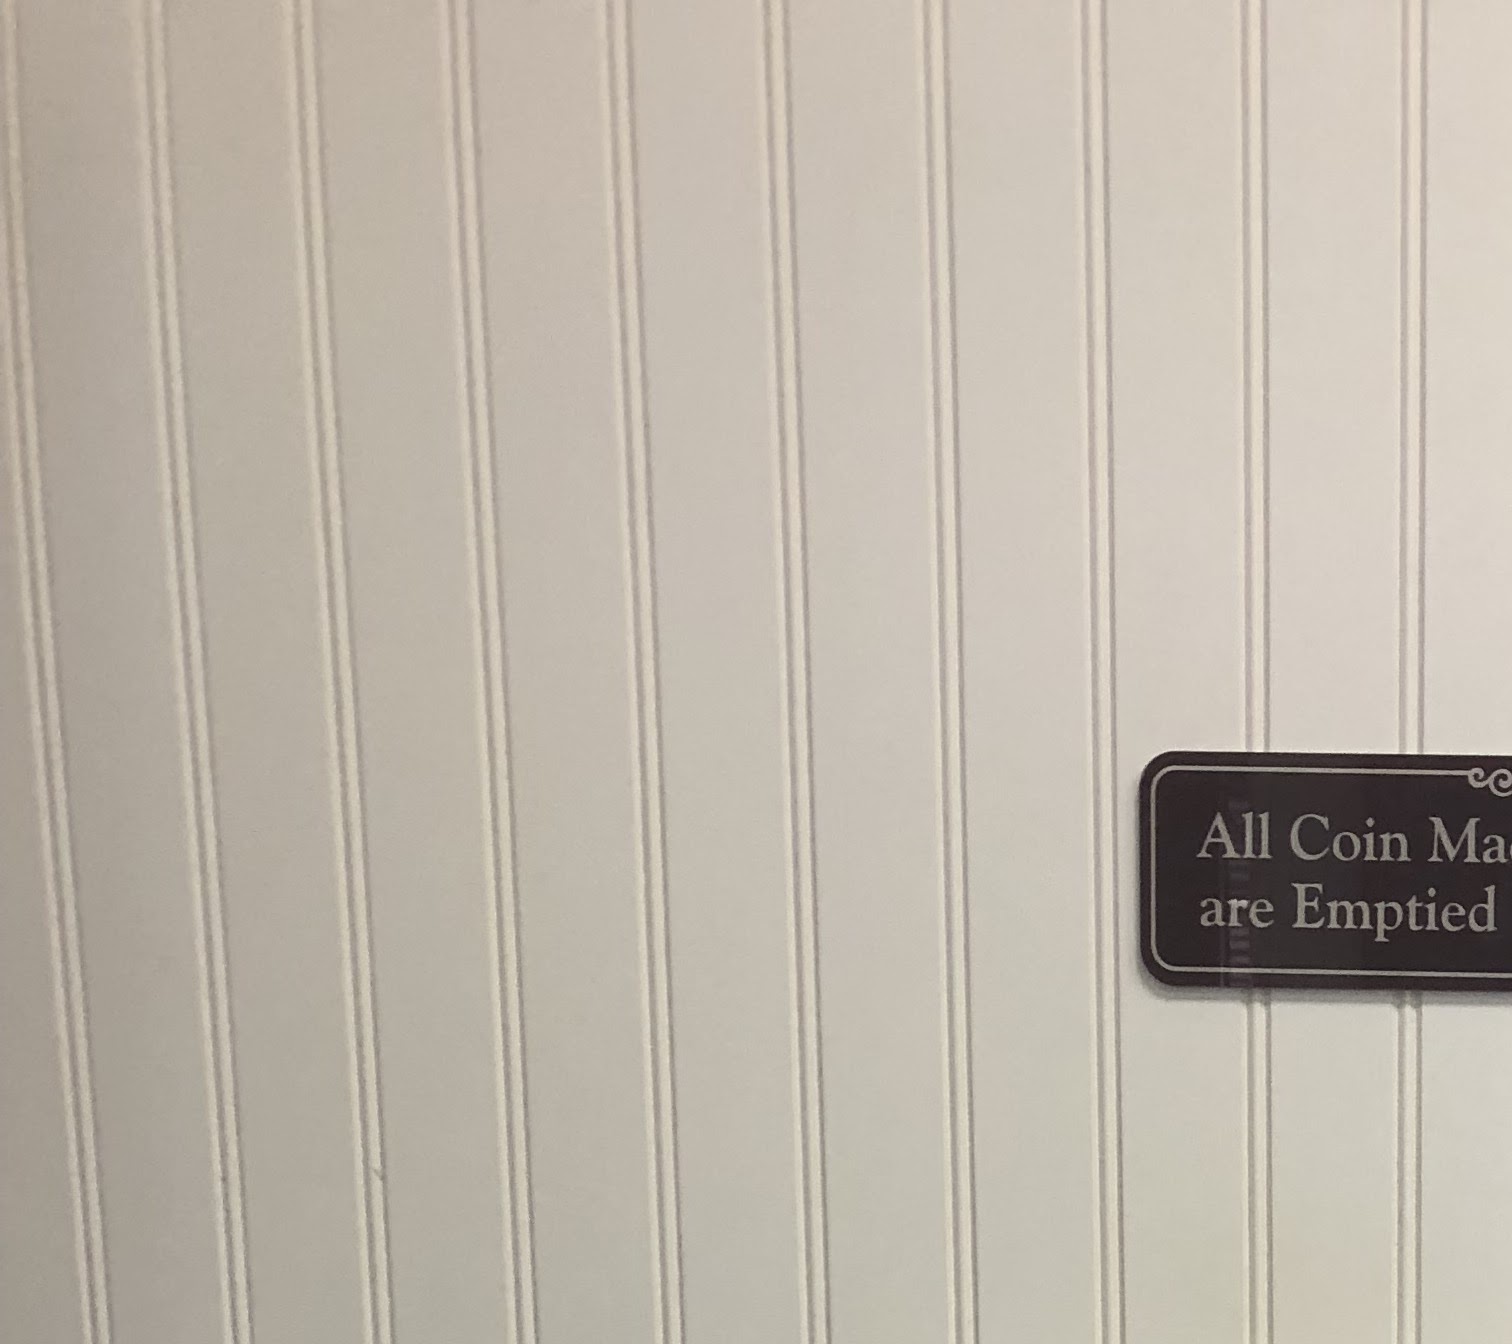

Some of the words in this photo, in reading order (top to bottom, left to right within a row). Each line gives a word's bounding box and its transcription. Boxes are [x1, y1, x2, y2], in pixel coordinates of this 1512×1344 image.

[1197, 812, 1272, 862] All
[1290, 815, 1411, 863] Coin
[1200, 897, 1274, 930] are
[1292, 884, 1497, 942] Emptied
